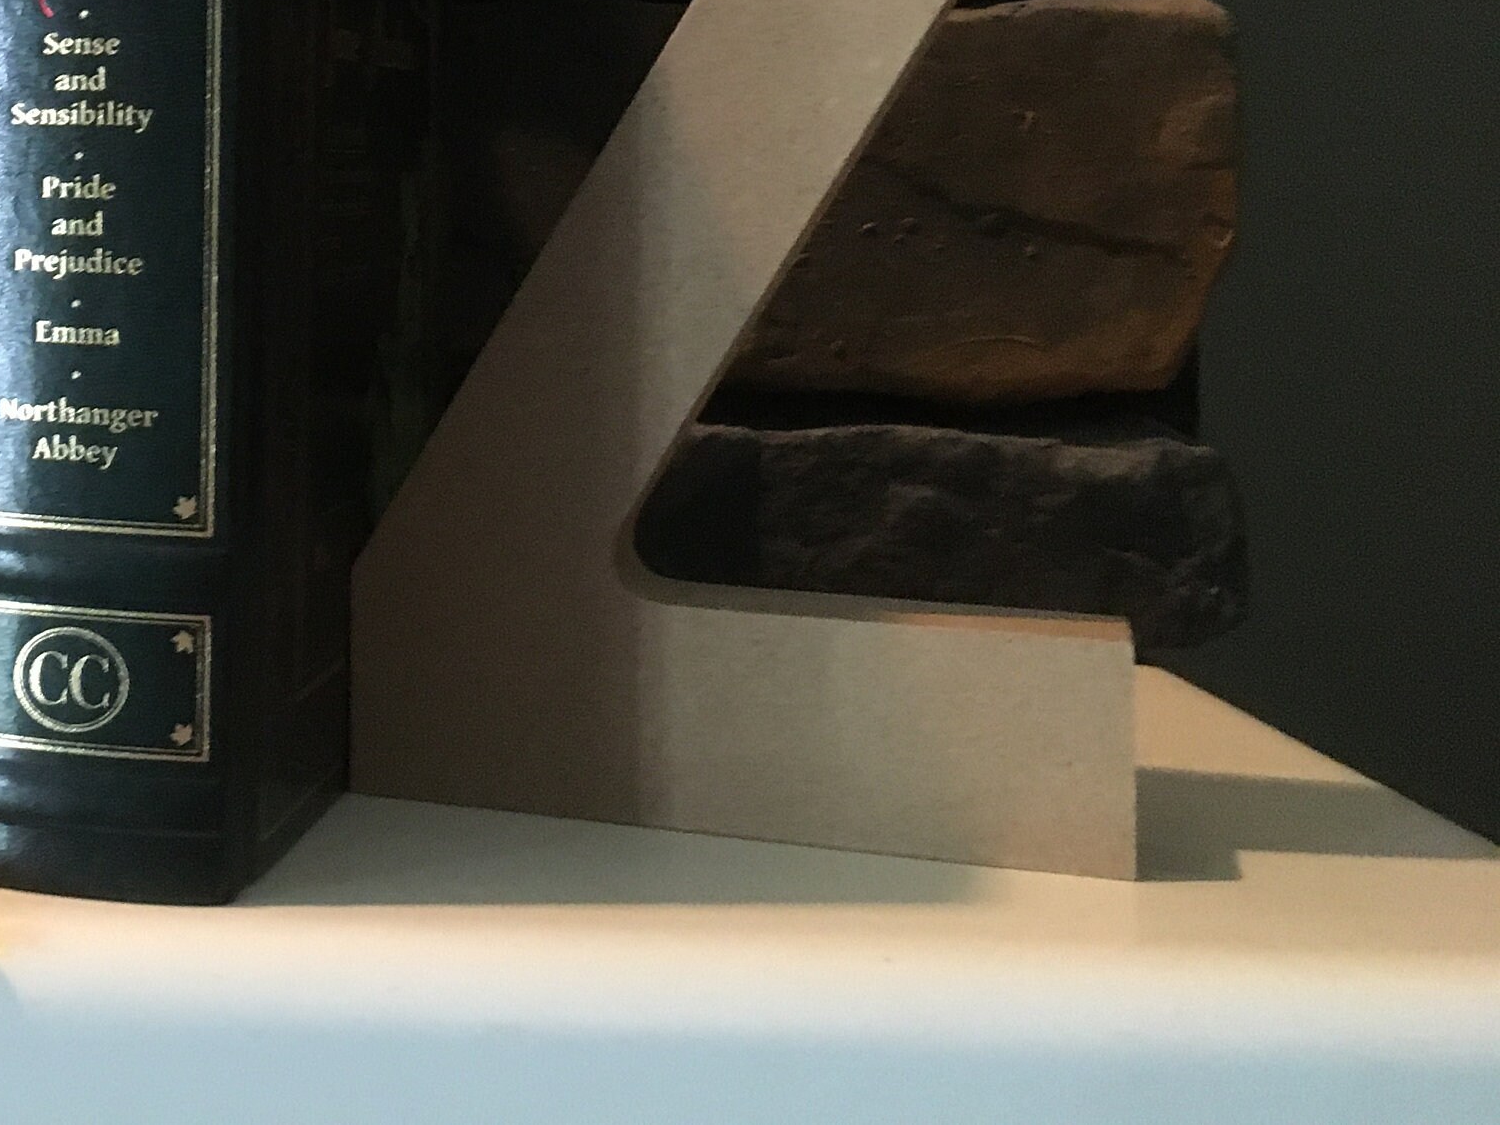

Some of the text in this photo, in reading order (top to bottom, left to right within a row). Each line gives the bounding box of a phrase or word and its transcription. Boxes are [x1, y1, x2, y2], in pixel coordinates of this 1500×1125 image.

[42, 32, 121, 56] Sense
[54, 66, 107, 91] and
[10, 99, 154, 134] Sensibility
[41, 173, 117, 199] Pride
[51, 210, 104, 236] and
[14, 248, 144, 280] Prejudice
[35, 320, 121, 346] Emma
[0, 396, 159, 434] Northanger
[32, 433, 118, 470] Abbey
